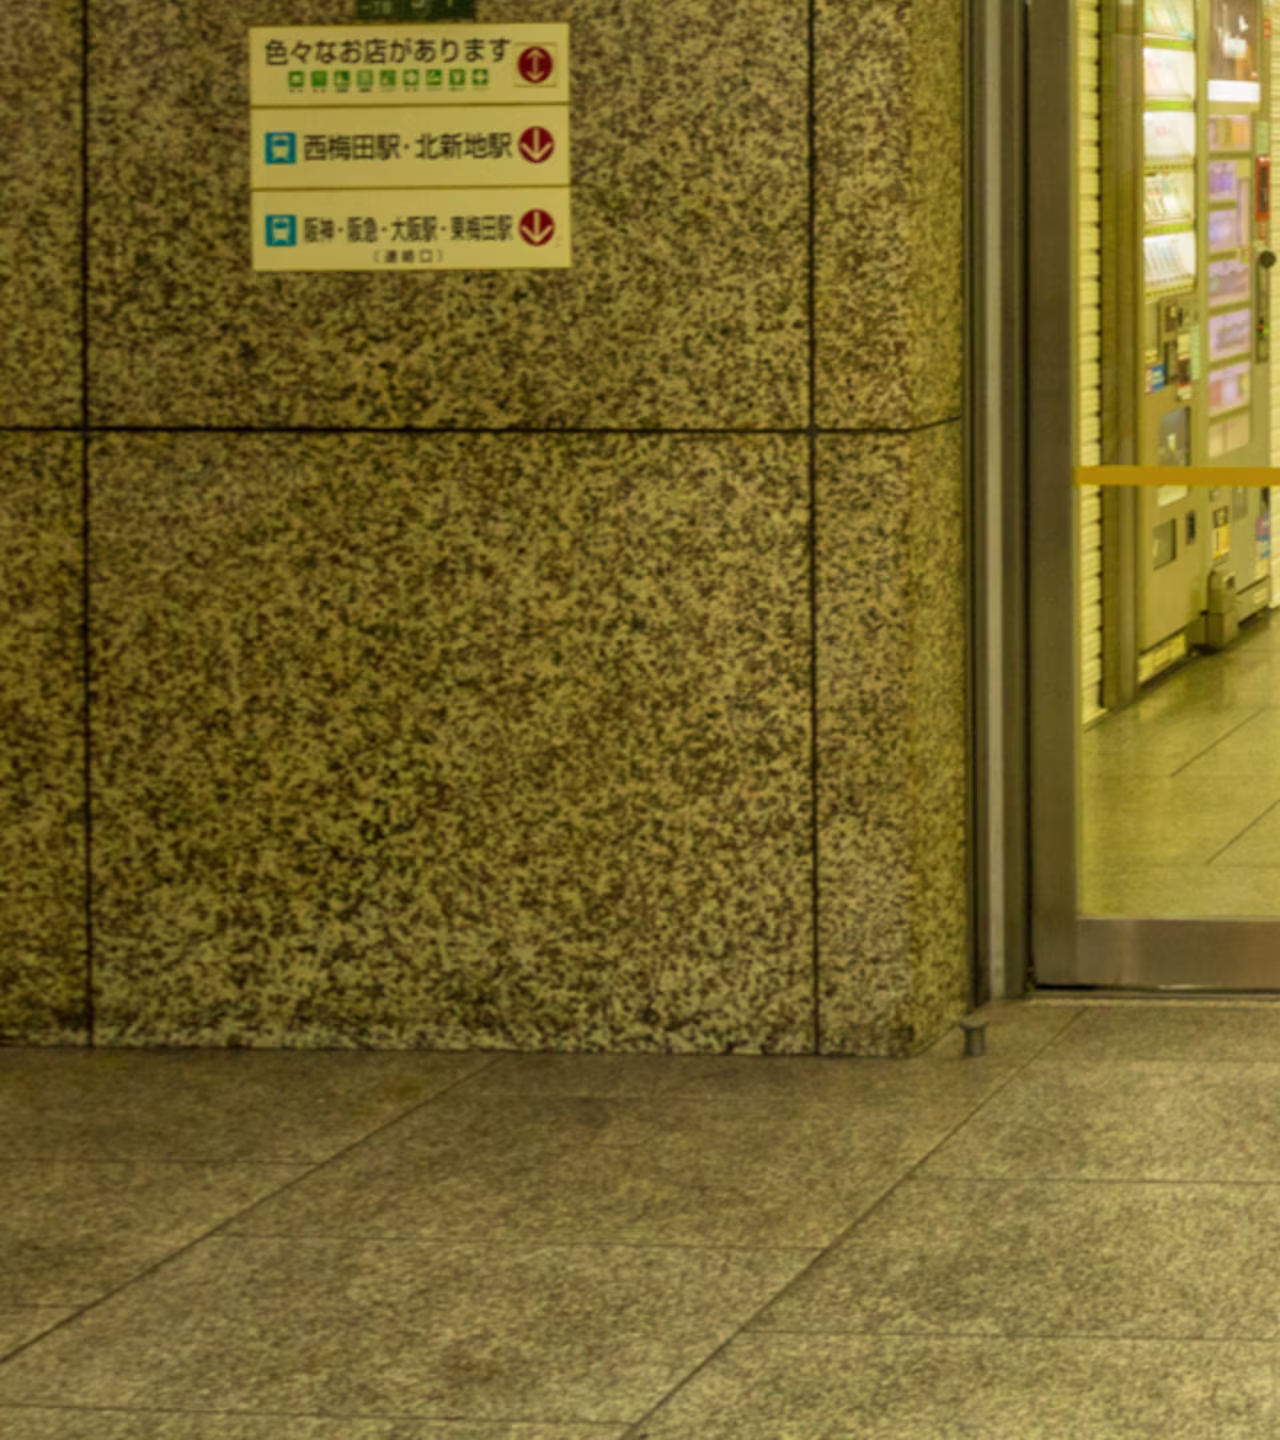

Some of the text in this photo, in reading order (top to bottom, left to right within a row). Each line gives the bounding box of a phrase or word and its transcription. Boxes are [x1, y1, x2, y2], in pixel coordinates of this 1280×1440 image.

[265, 37, 511, 66] 色々なお店があります
[303, 132, 513, 161] 西梅田駅・北新地駅
